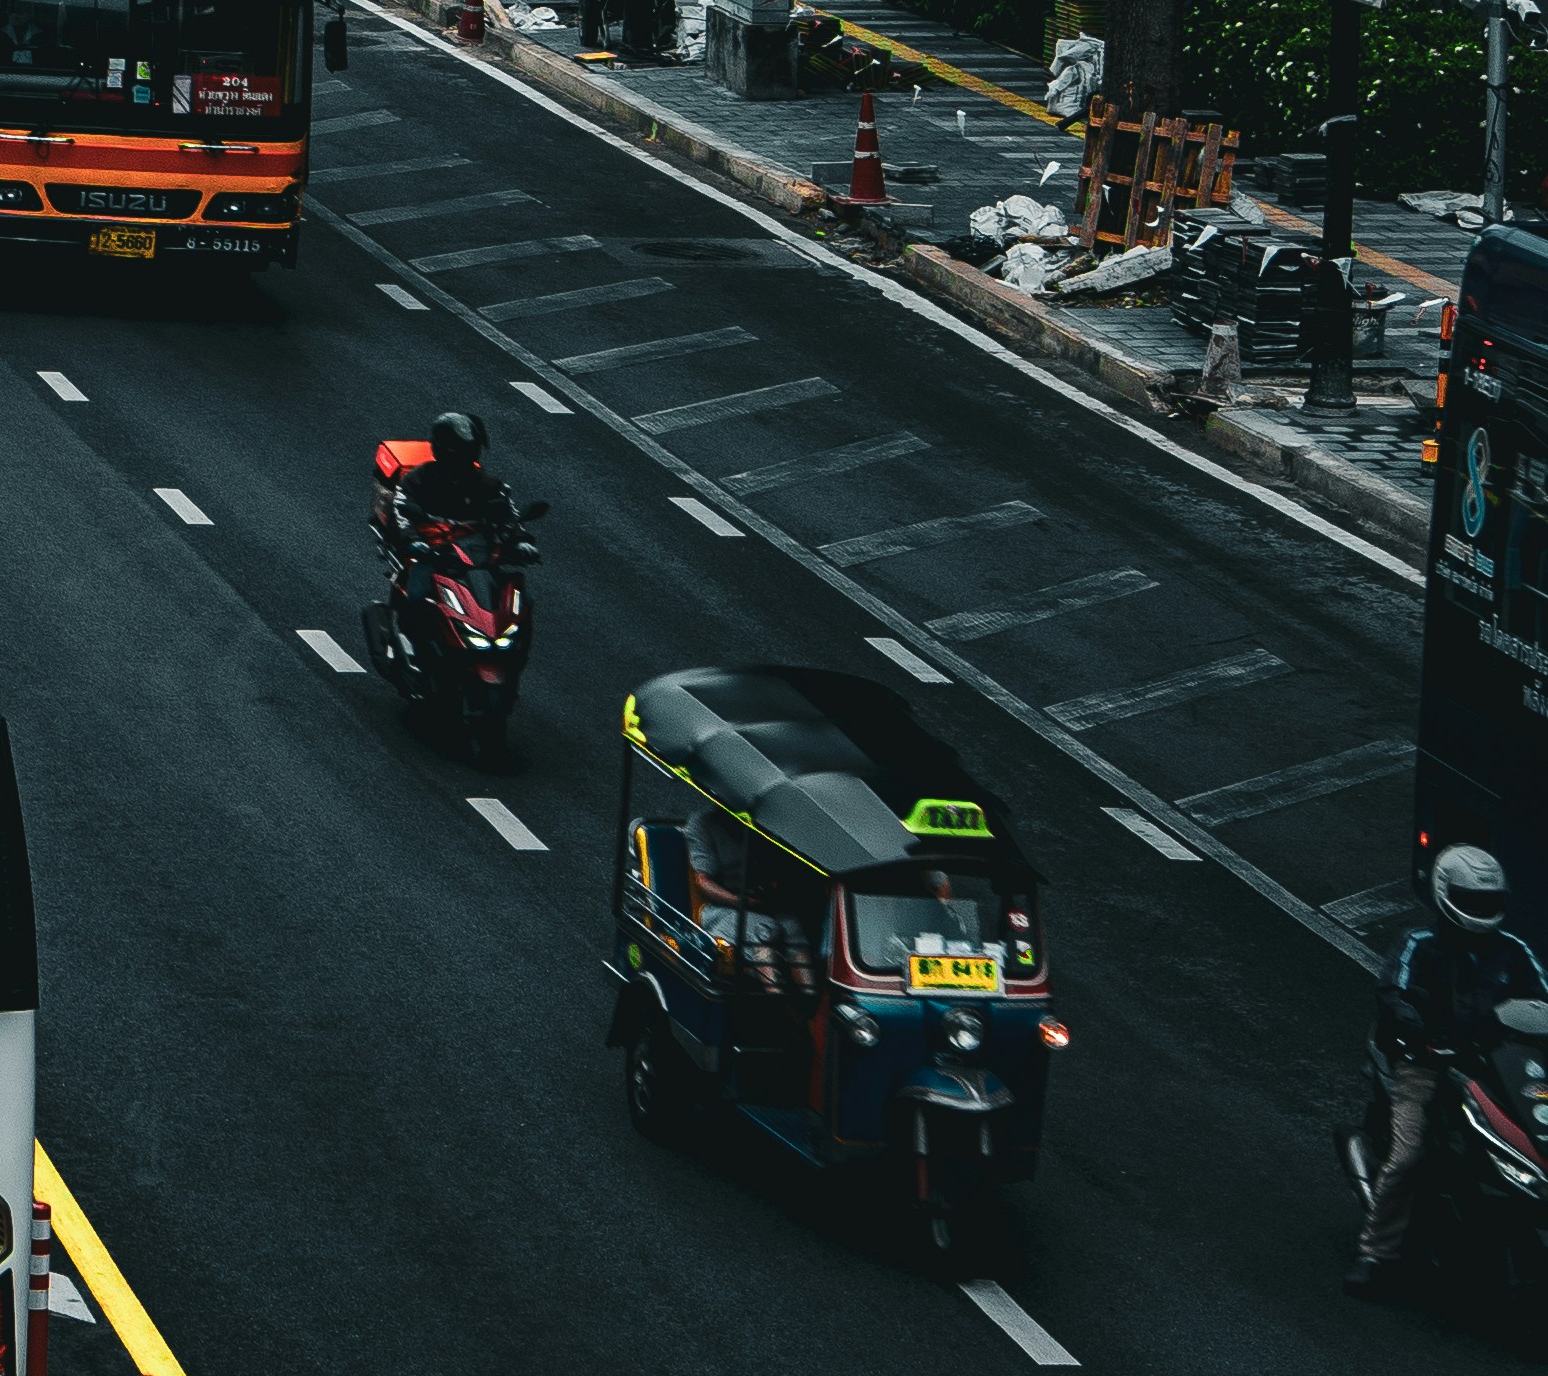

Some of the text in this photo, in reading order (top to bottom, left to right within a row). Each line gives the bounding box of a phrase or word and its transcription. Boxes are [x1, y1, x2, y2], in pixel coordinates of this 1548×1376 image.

[222, 76, 248, 87] 204
[81, 191, 166, 211] ISUZU
[928, 807, 981, 830] TAXI
